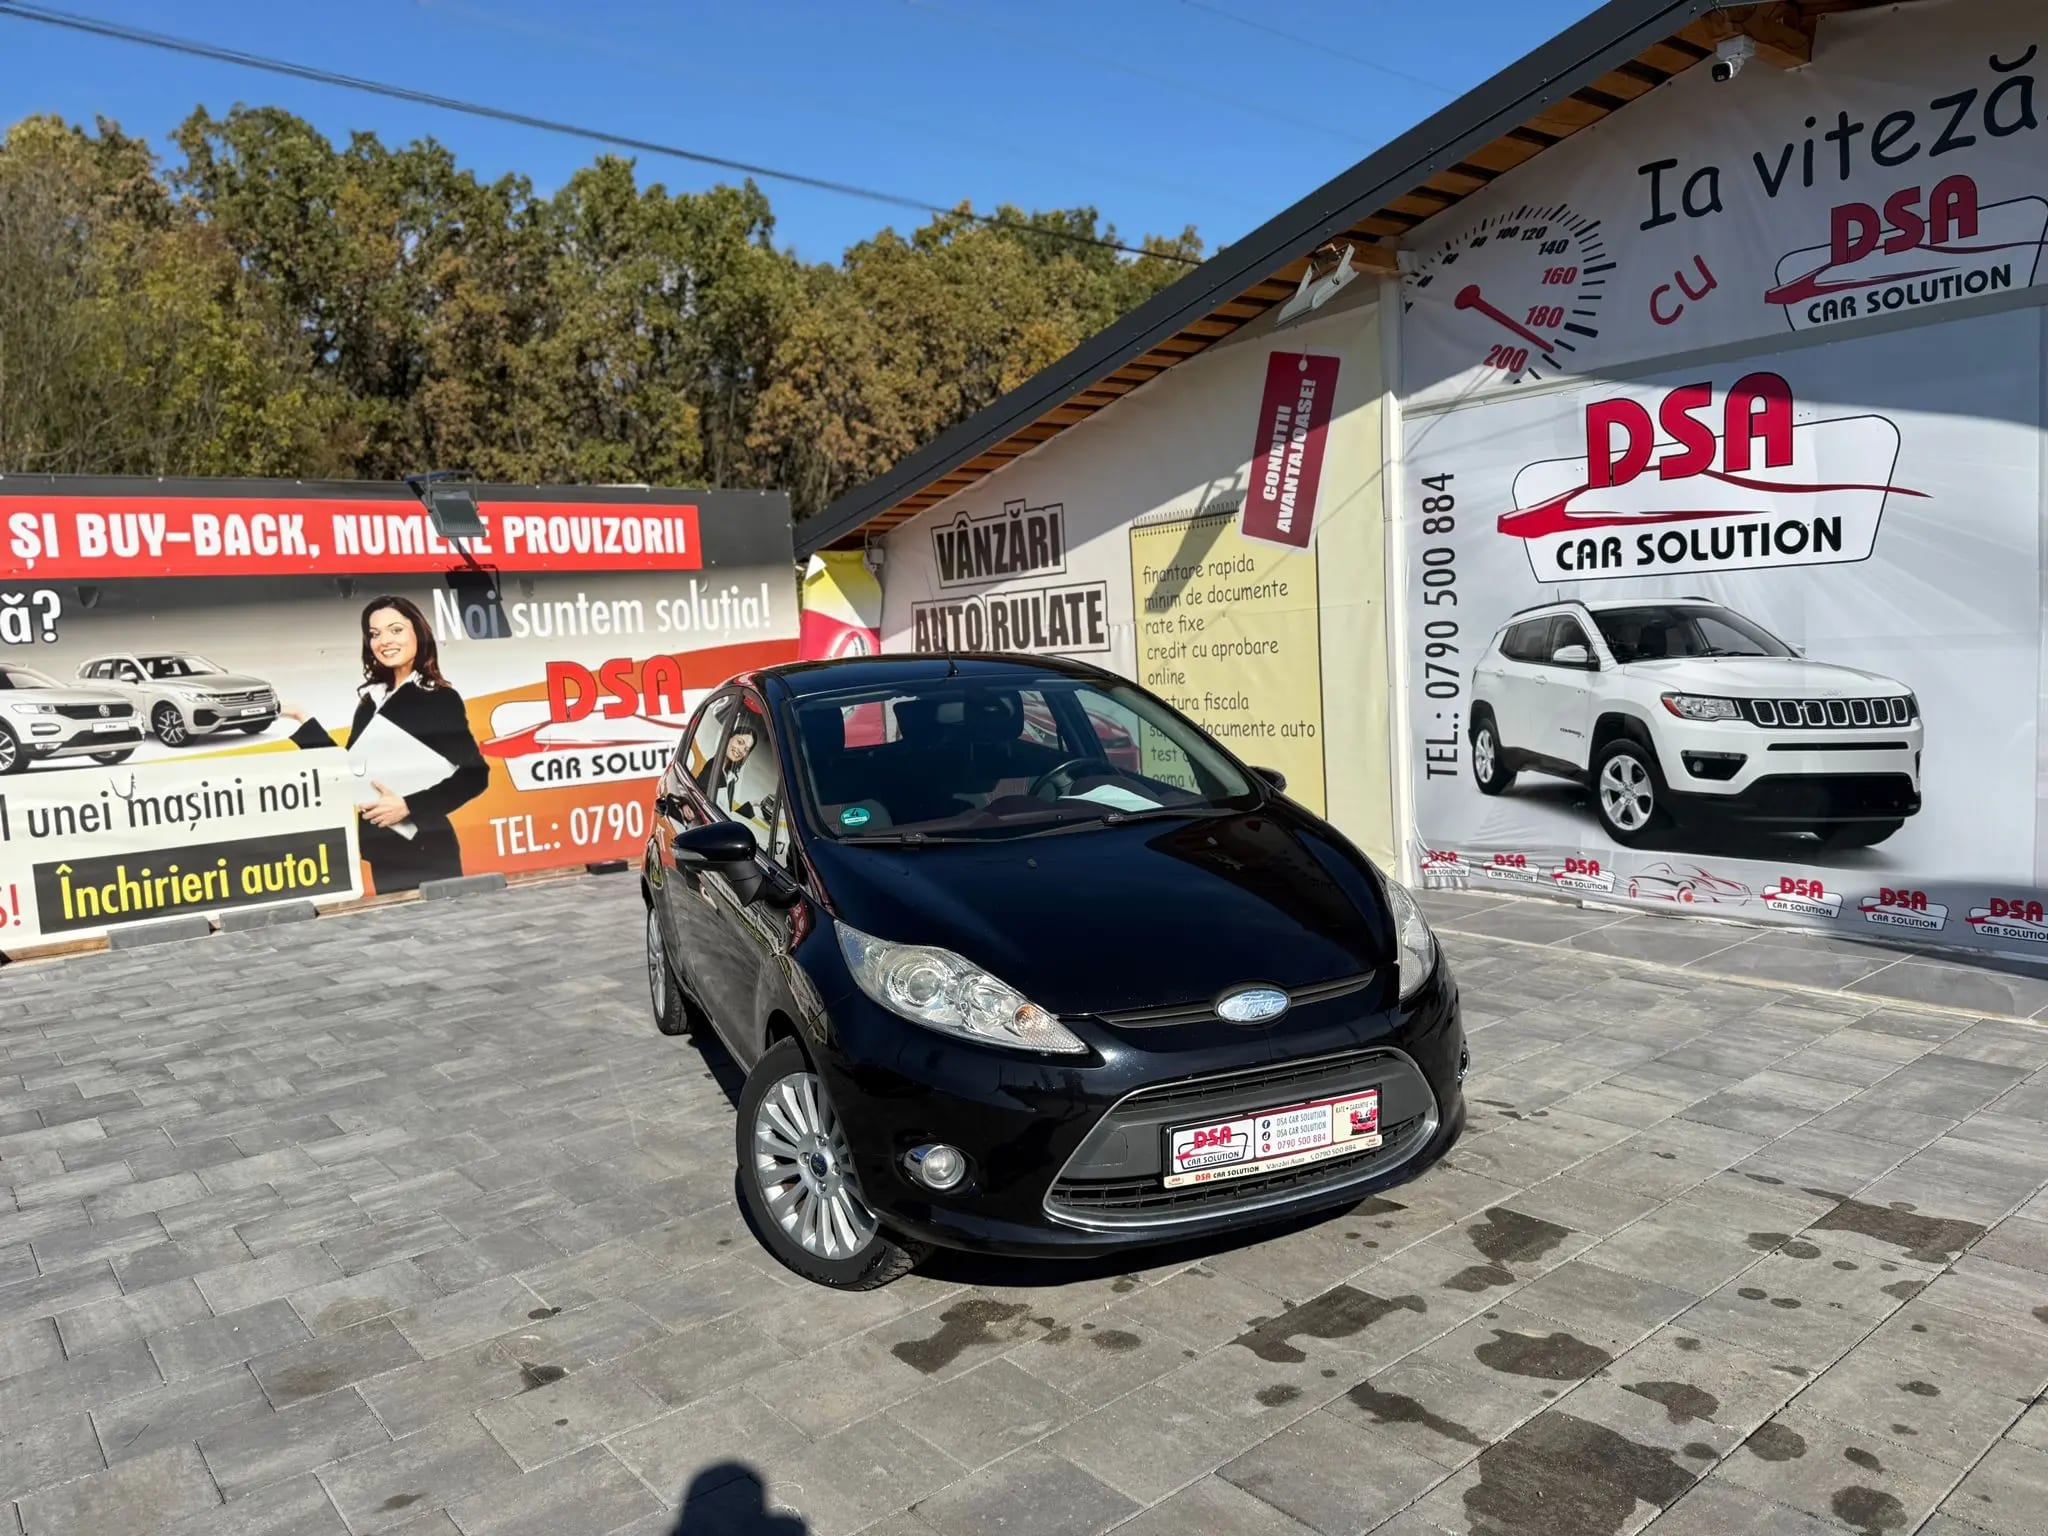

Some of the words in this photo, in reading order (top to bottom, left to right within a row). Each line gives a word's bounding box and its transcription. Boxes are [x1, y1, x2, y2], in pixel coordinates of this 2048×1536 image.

[1638, 158, 1723, 231] Ia
[1753, 44, 2038, 198] viteză
[1830, 174, 1978, 266] DSA
[1541, 266, 1577, 285] 160
[1649, 255, 1718, 326] cu
[1807, 298, 1857, 325] CAR
[1867, 264, 2012, 316] SOLUTION
[1525, 305, 1565, 328] 180
[1483, 343, 1529, 373] 200
[1585, 371, 1794, 490] DSA
[1263, 404, 1292, 502] CONDITII
[1276, 378, 1316, 534] AVANTAJOASE!
[1421, 472, 1456, 535] 884
[8, 512, 60, 570] ȘI
[502, 516, 686, 555] PROVIZORII
[936, 508, 1061, 581] VÂNZĂRI
[1556, 535, 1623, 571] CAR
[1636, 516, 1842, 565] SOLUTION
[1143, 563, 1204, 585] finantare
[1208, 553, 1255, 580] rapida
[1422, 547, 1459, 607] 500
[1144, 593, 1182, 610] minim
[1186, 587, 1203, 606] de
[1207, 580, 1289, 603] documente
[432, 588, 500, 641] Noi
[512, 592, 644, 638] suntem
[655, 579, 772, 638] soluția!
[914, 601, 985, 653] AUTO
[990, 589, 1105, 651] RULATE
[1145, 617, 1174, 635] rate
[1179, 614, 1205, 633] fixe
[1147, 641, 1187, 660] credit
[1192, 644, 1207, 658] cu
[1211, 637, 1279, 662] aprobare
[1424, 620, 1460, 700] 0790
[545, 654, 686, 723] DSA
[1148, 668, 1186, 685] online
[1204, 691, 1249, 711] fiscala
[1280, 720, 1316, 738] auto
[1151, 746, 1177, 762] test
[1425, 712, 1460, 781] TEL.:
[531, 757, 581, 782] CAR
[27, 790, 112, 838] unei
[127, 777, 245, 831] mașini
[258, 769, 322, 813] noi!
[490, 814, 561, 857] TEL.:
[569, 801, 644, 846] 0790
[1494, 854, 1526, 868] DSA
[1565, 857, 1600, 876] DSA
[55, 859, 230, 920] Închirieri
[240, 844, 330, 894] auto!
[1560, 879, 1574, 887] CAR
[1574, 880, 1609, 891] SOLUTION
[1780, 876, 1824, 899] DSA
[1772, 901, 1788, 911] CAR
[1790, 902, 1833, 916] SOLUTION
[1879, 887, 1927, 911] DSA
[1990, 897, 2044, 922] DSA
[1871, 913, 1890, 924] CAR
[1891, 914, 1938, 929] SOLUTION
[1980, 924, 2001, 936] CAR
[2002, 926, 2048, 942] SOLUTIO
[1276, 1117, 1288, 1127] DSA
[1288, 1114, 1299, 1125] CAR
[1300, 1110, 1327, 1122] SOLUTION
[1276, 1128, 1288, 1138] DSA
[1288, 1126, 1299, 1136] CAR
[1300, 1121, 1327, 1134] SOLUTION
[1193, 1126, 1232, 1149] DSA
[1277, 1139, 1296, 1150] 0790
[1298, 1136, 1311, 1147] 500
[1312, 1133, 1326, 1144] 884
[1187, 1157, 1201, 1167] CAR
[1203, 1151, 1239, 1164] SOLUTION
[1195, 1172, 1211, 1182] DSA
[1227, 1166, 1260, 1177] SOLUTION
